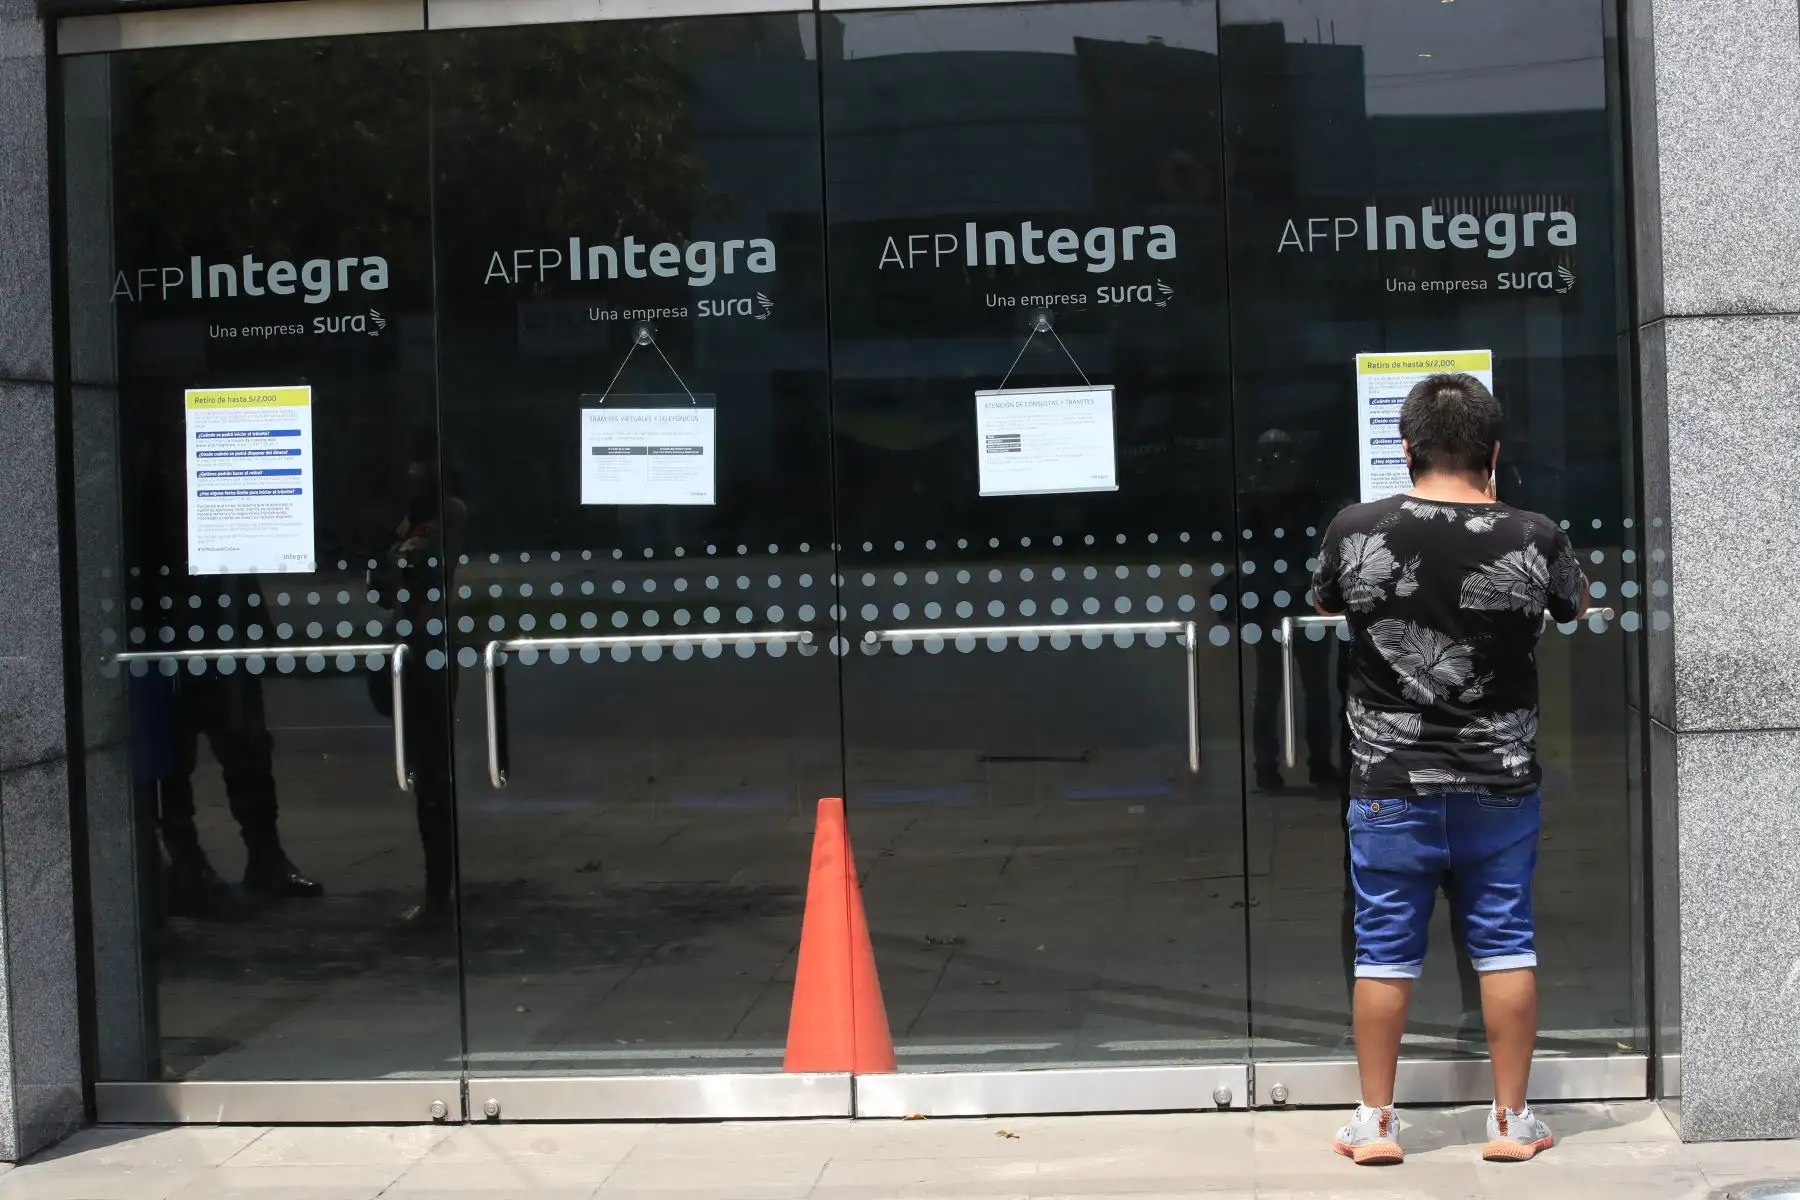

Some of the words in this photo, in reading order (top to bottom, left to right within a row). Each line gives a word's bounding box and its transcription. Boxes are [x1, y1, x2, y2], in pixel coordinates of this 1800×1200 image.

[1277, 217, 1359, 253] AFP
[1365, 205, 1577, 259] Integra
[878, 233, 958, 270] AFP
[965, 220, 1177, 273] Integra
[484, 248, 563, 285] AFP
[569, 235, 777, 287] Integra
[110, 267, 184, 302] AFP
[190, 254, 389, 304] Integra
[1386, 278, 1416, 292] Una
[1420, 277, 1488, 294] empresa
[1497, 271, 1553, 290] sura
[986, 294, 1015, 307] Una
[1020, 293, 1087, 309] empresa
[1096, 285, 1152, 304] sura
[589, 307, 618, 321] Una
[623, 306, 688, 322] empresa
[698, 298, 752, 317] sura
[209, 324, 237, 338] Una
[242, 324, 304, 339] empresa
[313, 314, 366, 334] sura
[1367, 361, 1390, 369] Retiro
[1425, 359, 1455, 368] S/2,000
[217, 396, 226, 404] de
